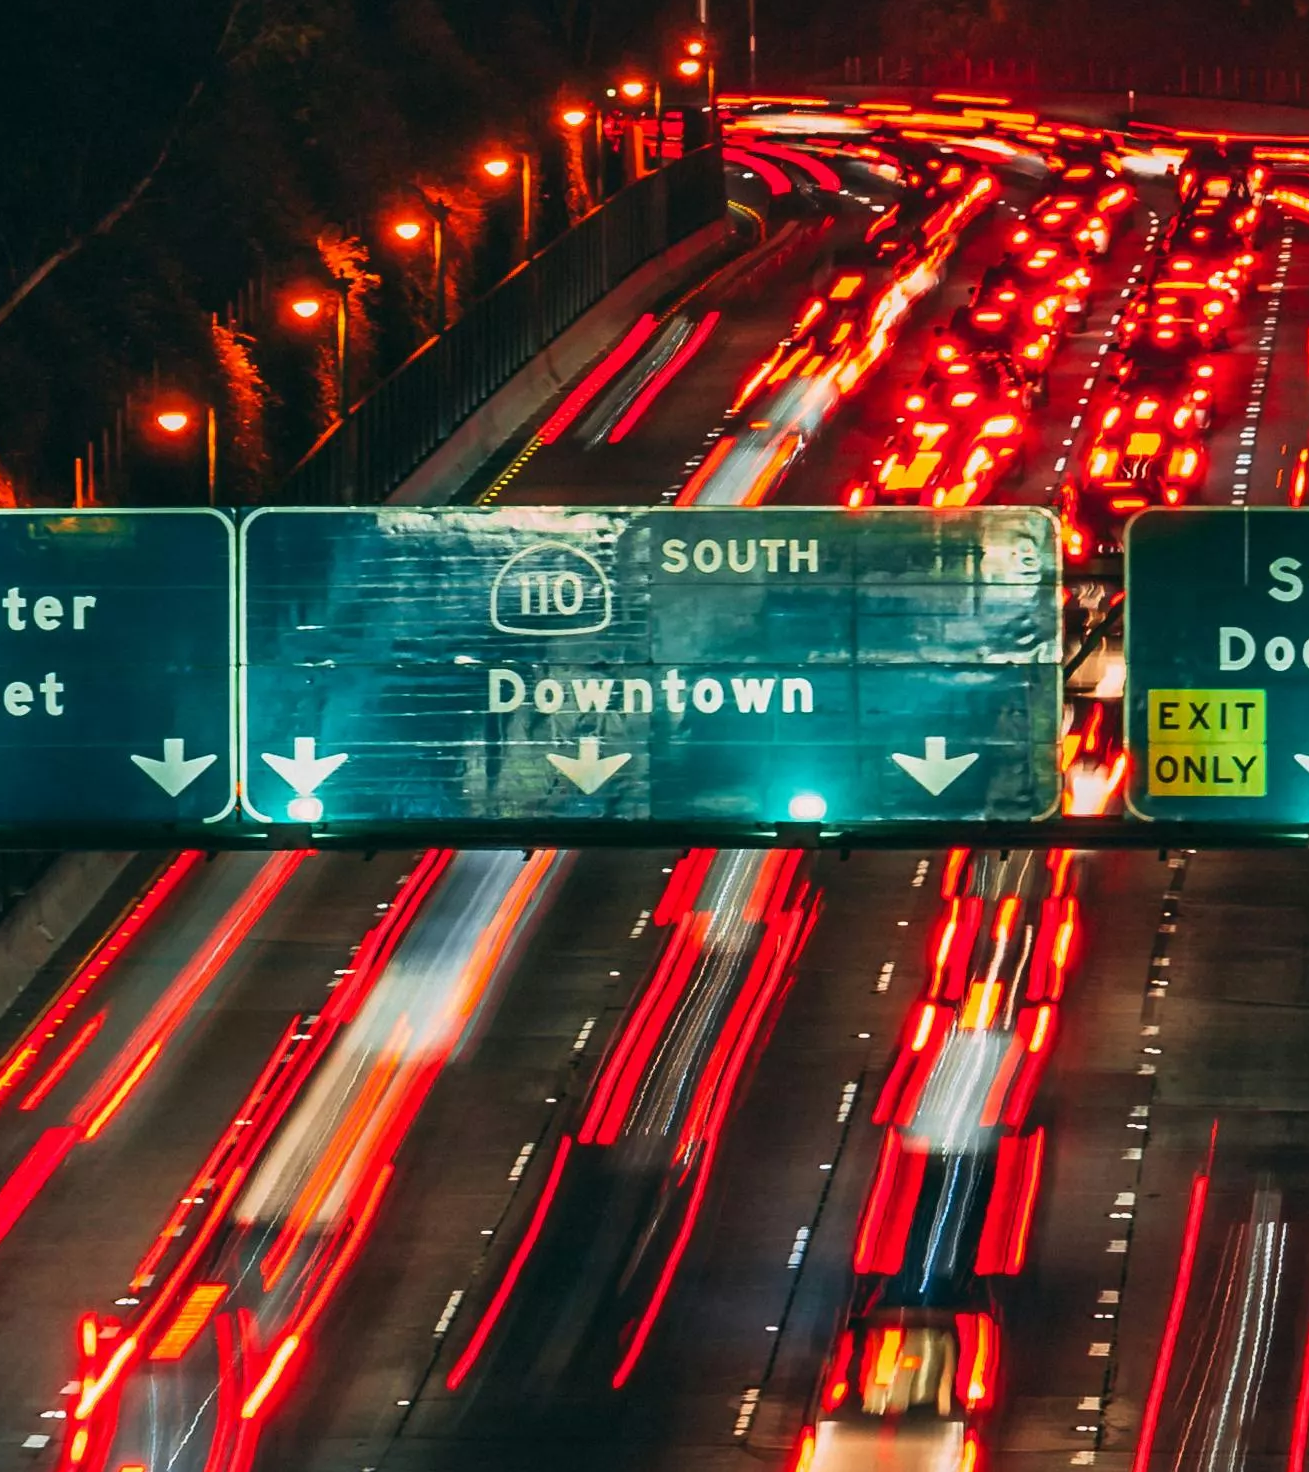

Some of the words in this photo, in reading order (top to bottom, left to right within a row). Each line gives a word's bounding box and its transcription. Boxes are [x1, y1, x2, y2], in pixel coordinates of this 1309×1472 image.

[661, 539, 818, 573] SOUTH
[520, 573, 584, 615] 110
[489, 669, 813, 714] Downtown
[1159, 702, 1255, 730] EXIT
[1156, 756, 1256, 783] ONLY
